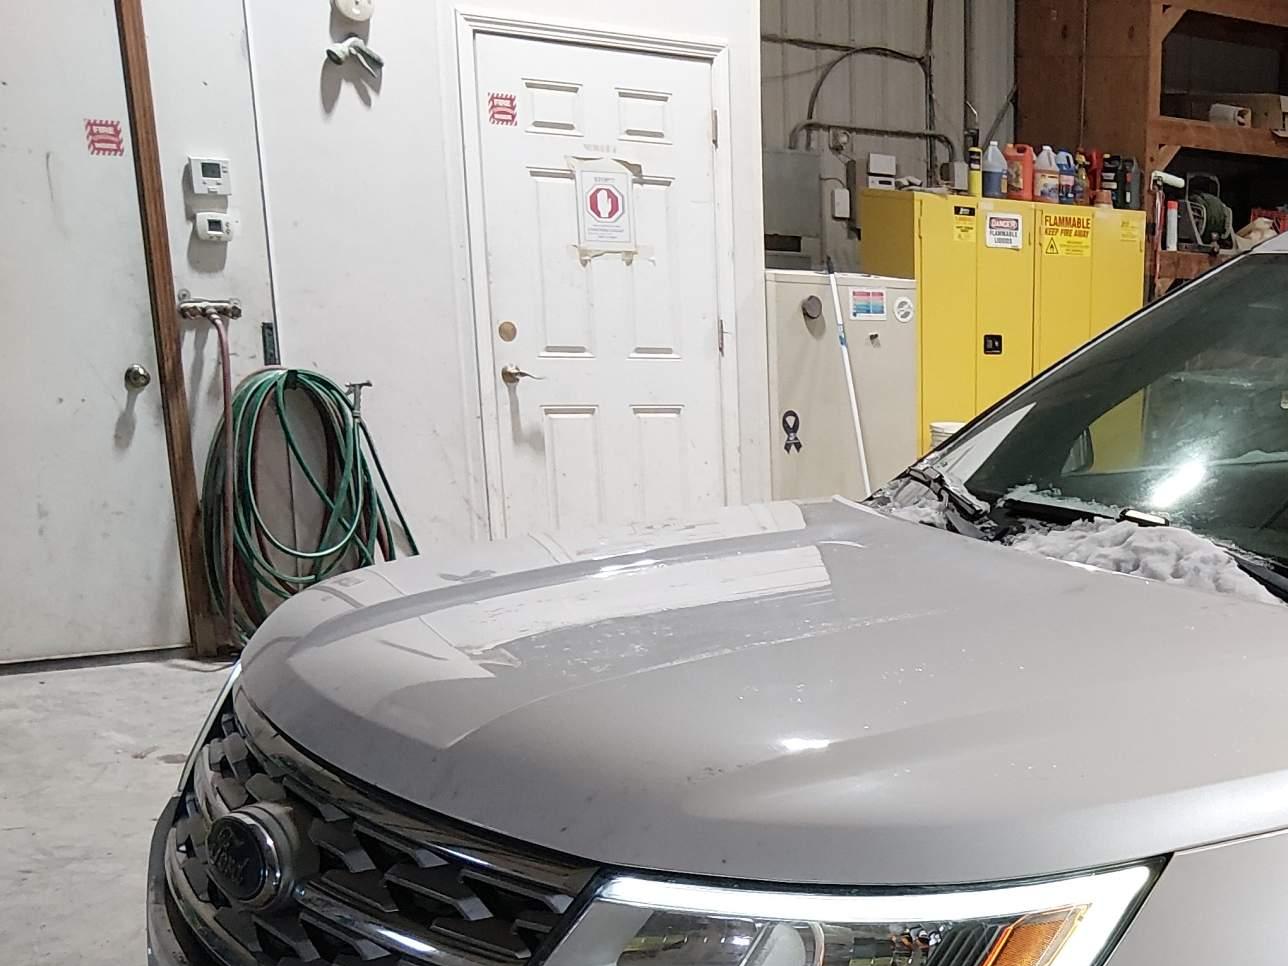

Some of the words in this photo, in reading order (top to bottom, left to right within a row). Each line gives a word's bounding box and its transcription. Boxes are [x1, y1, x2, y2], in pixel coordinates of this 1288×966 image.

[1044, 215, 1091, 229] FLAMMABLE
[990, 230, 1018, 238] FLAMMABLE
[1045, 228, 1059, 236] KEEP
[1060, 228, 1073, 237] FIRE
[1074, 229, 1090, 238] AWAY
